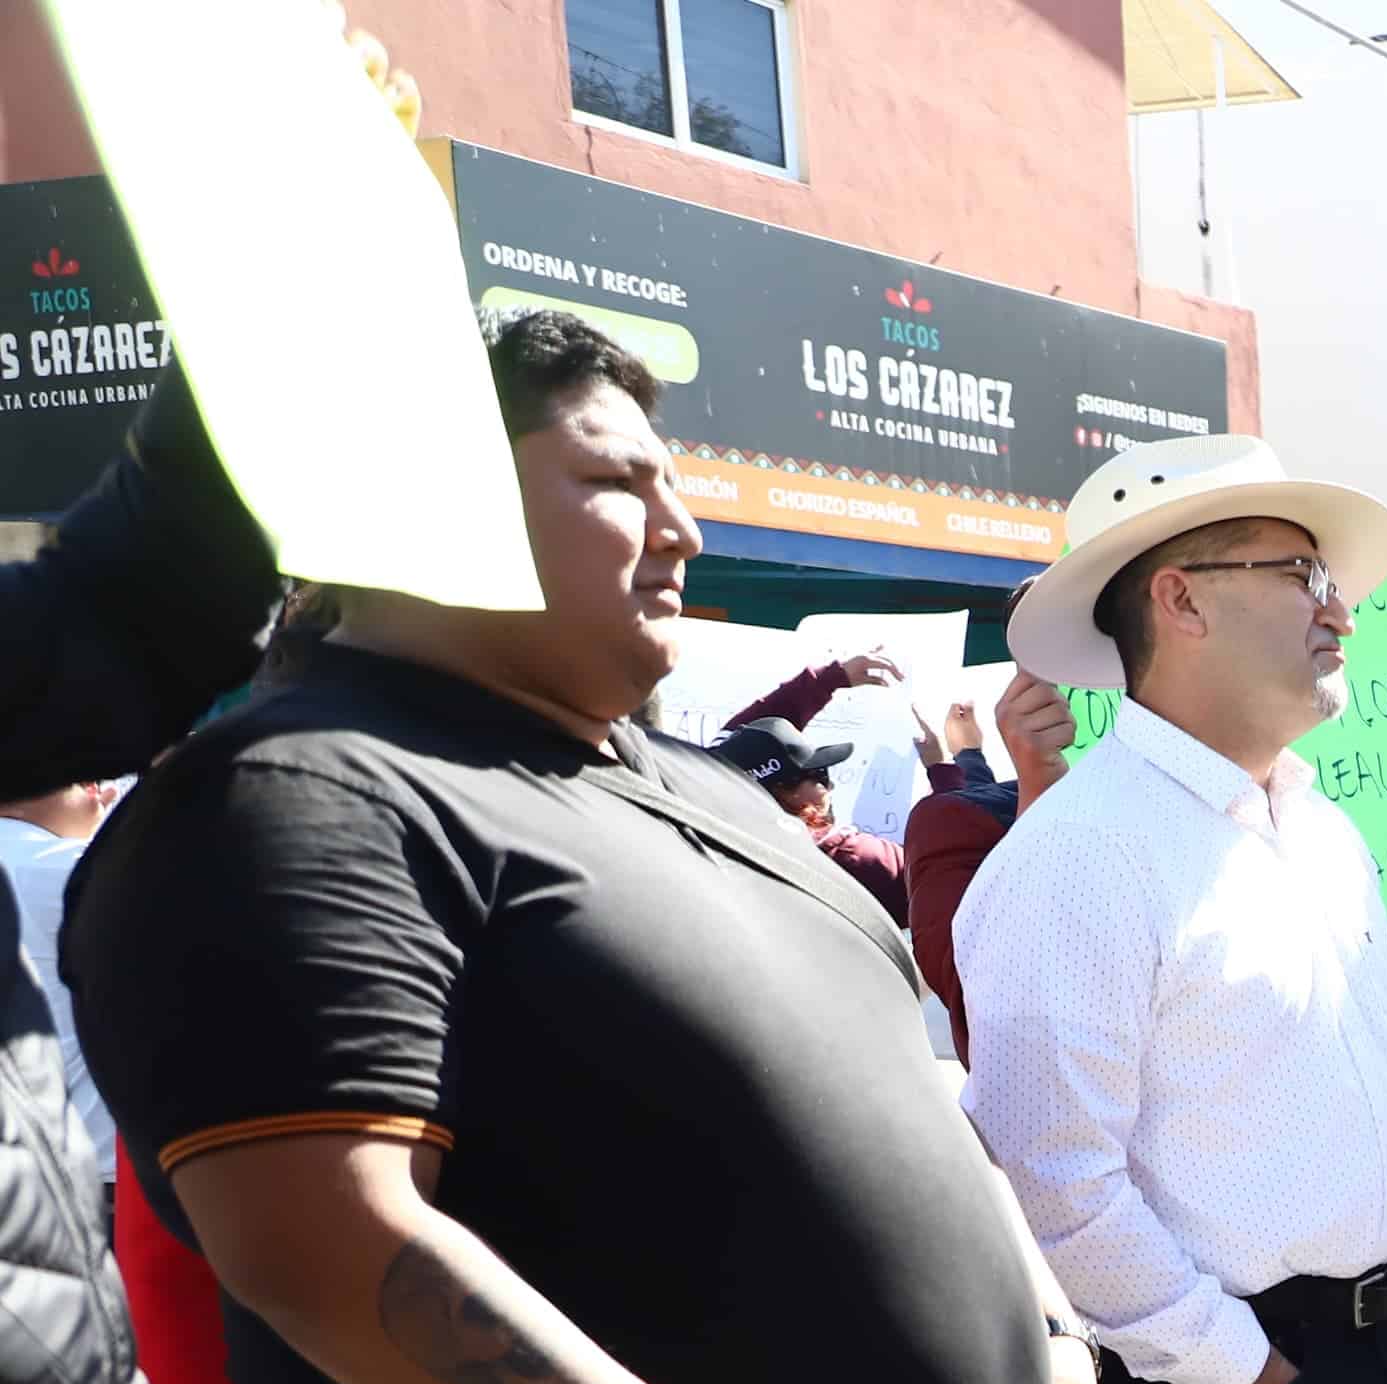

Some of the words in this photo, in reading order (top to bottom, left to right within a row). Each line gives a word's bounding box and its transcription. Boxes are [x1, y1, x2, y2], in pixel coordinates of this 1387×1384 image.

[483, 242, 579, 284] ORDENA
[581, 264, 597, 287] Y
[601, 268, 688, 308] RECOGE:
[31, 287, 90, 314] TACOS
[880, 317, 940, 351] TACOS
[802, 339, 869, 400] LOS
[879, 348, 1015, 428] CÁZAREZ
[0, 391, 23, 411] LTA
[29, 389, 89, 409] COCINA
[830, 410, 869, 432] ALTA
[875, 418, 934, 444] COCINA
[938, 429, 998, 456] URBANA
[1148, 407, 1167, 428] EN
[673, 473, 738, 501] ARRÓN
[768, 487, 847, 515] CHORIZO
[848, 497, 920, 527] ESPAÑOL
[947, 512, 990, 537] CHILE
